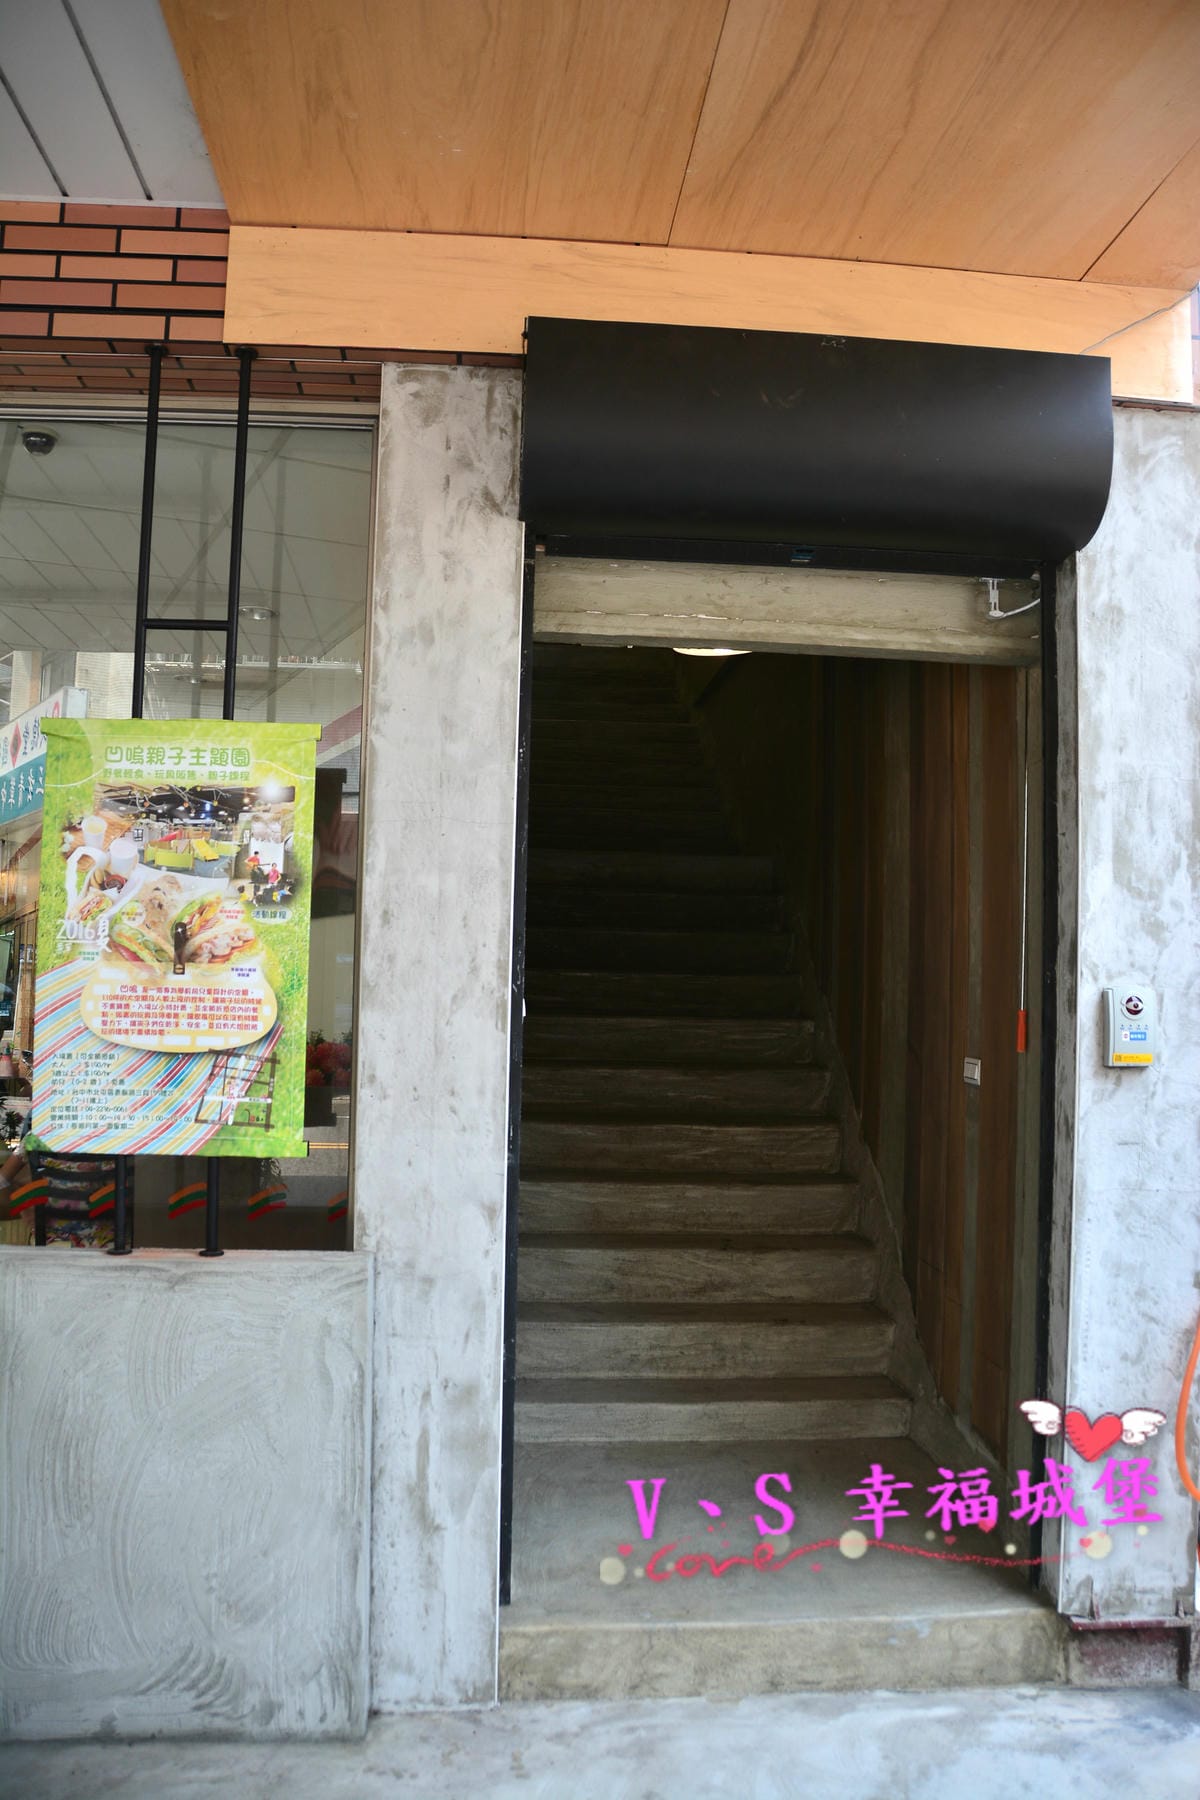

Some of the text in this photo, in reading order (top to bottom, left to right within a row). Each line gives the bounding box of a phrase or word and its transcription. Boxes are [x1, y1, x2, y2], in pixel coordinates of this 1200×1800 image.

[104, 745, 251, 767] 凹嗚親子主題園
[251, 909, 287, 920] 活動課程
